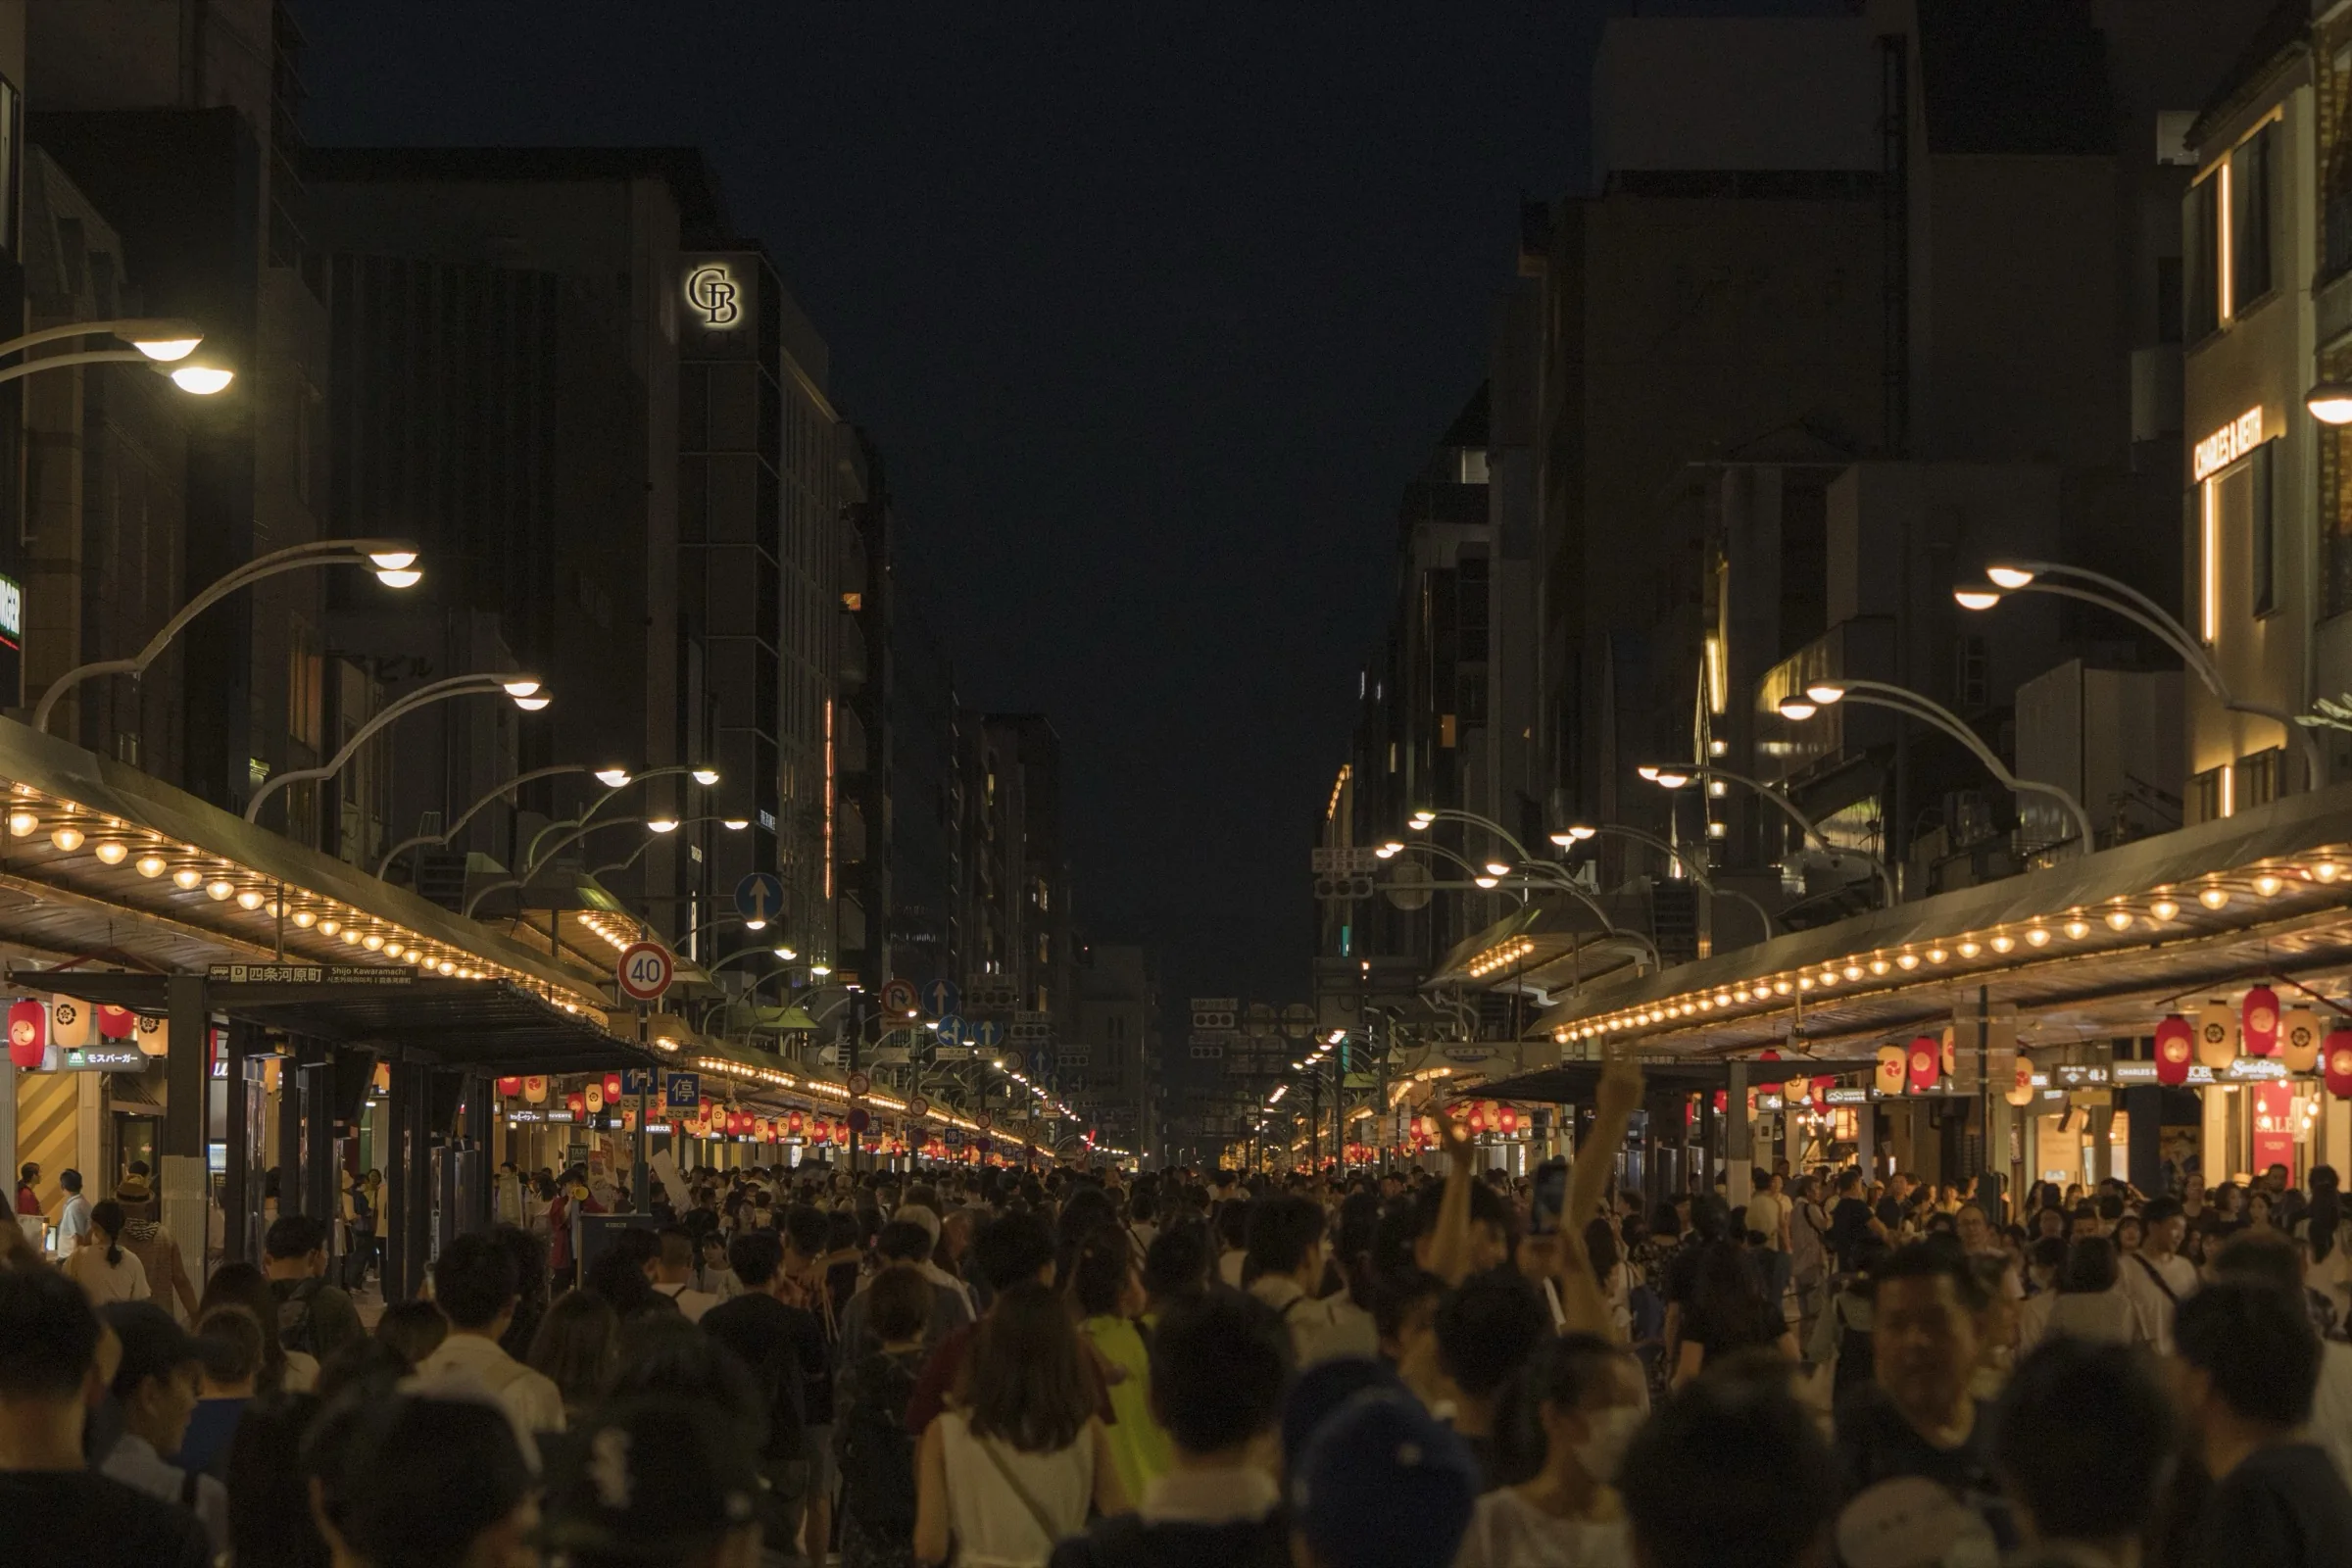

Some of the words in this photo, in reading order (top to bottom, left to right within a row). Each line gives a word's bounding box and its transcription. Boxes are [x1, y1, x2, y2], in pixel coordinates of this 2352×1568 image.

[234, 967, 243, 976] D
[249, 967, 322, 983] 四条河原町
[331, 966, 352, 976] Shijo
[353, 966, 407, 976] Kawaramachi
[631, 958, 660, 982] 40
[87, 1053, 138, 1063] モスバーガー
[2117, 1067, 2150, 1077] CHARLES
[671, 1078, 695, 1102] 停
[622, 1099, 657, 1107] ここら
[570, 1148, 587, 1156] TAXI
